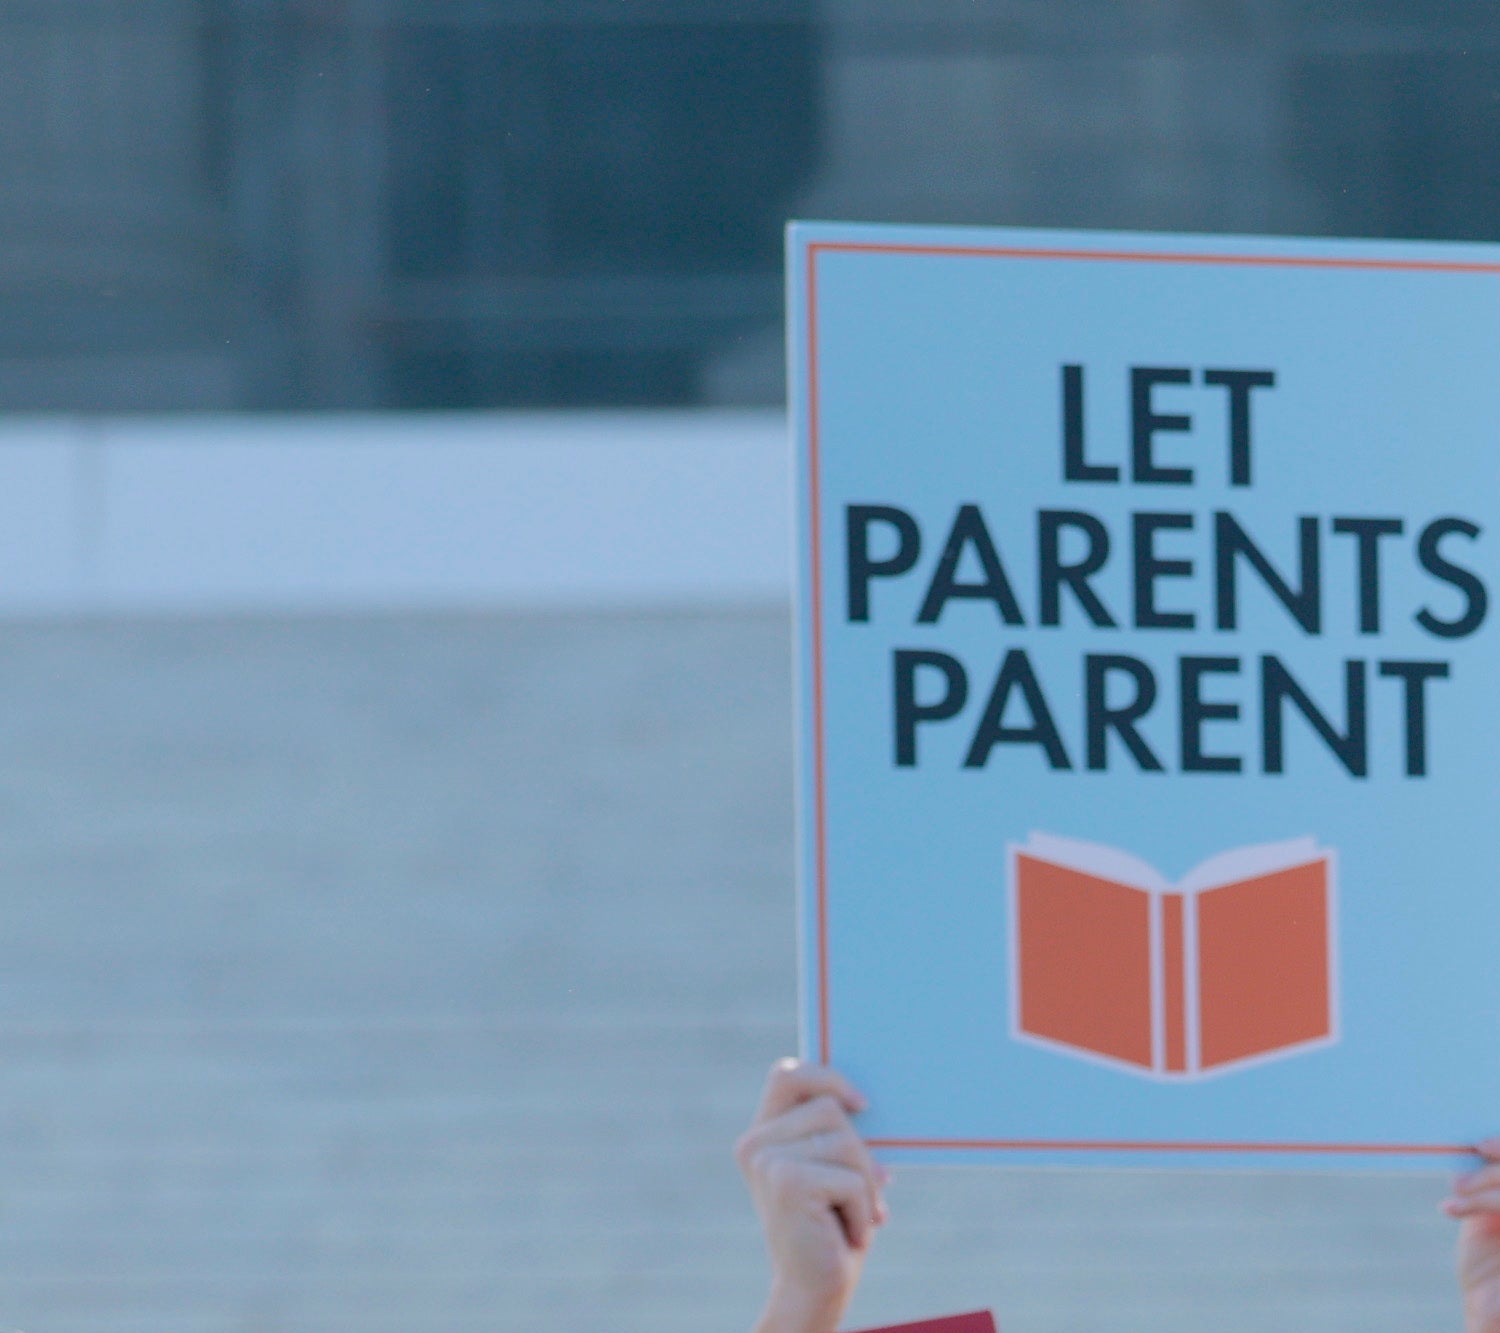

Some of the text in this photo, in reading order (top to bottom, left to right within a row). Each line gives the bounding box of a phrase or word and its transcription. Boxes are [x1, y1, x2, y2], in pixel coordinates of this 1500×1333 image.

[1062, 365, 1275, 487] LET
[846, 504, 1488, 639] PARENTS
[894, 648, 1449, 778] PARENT
